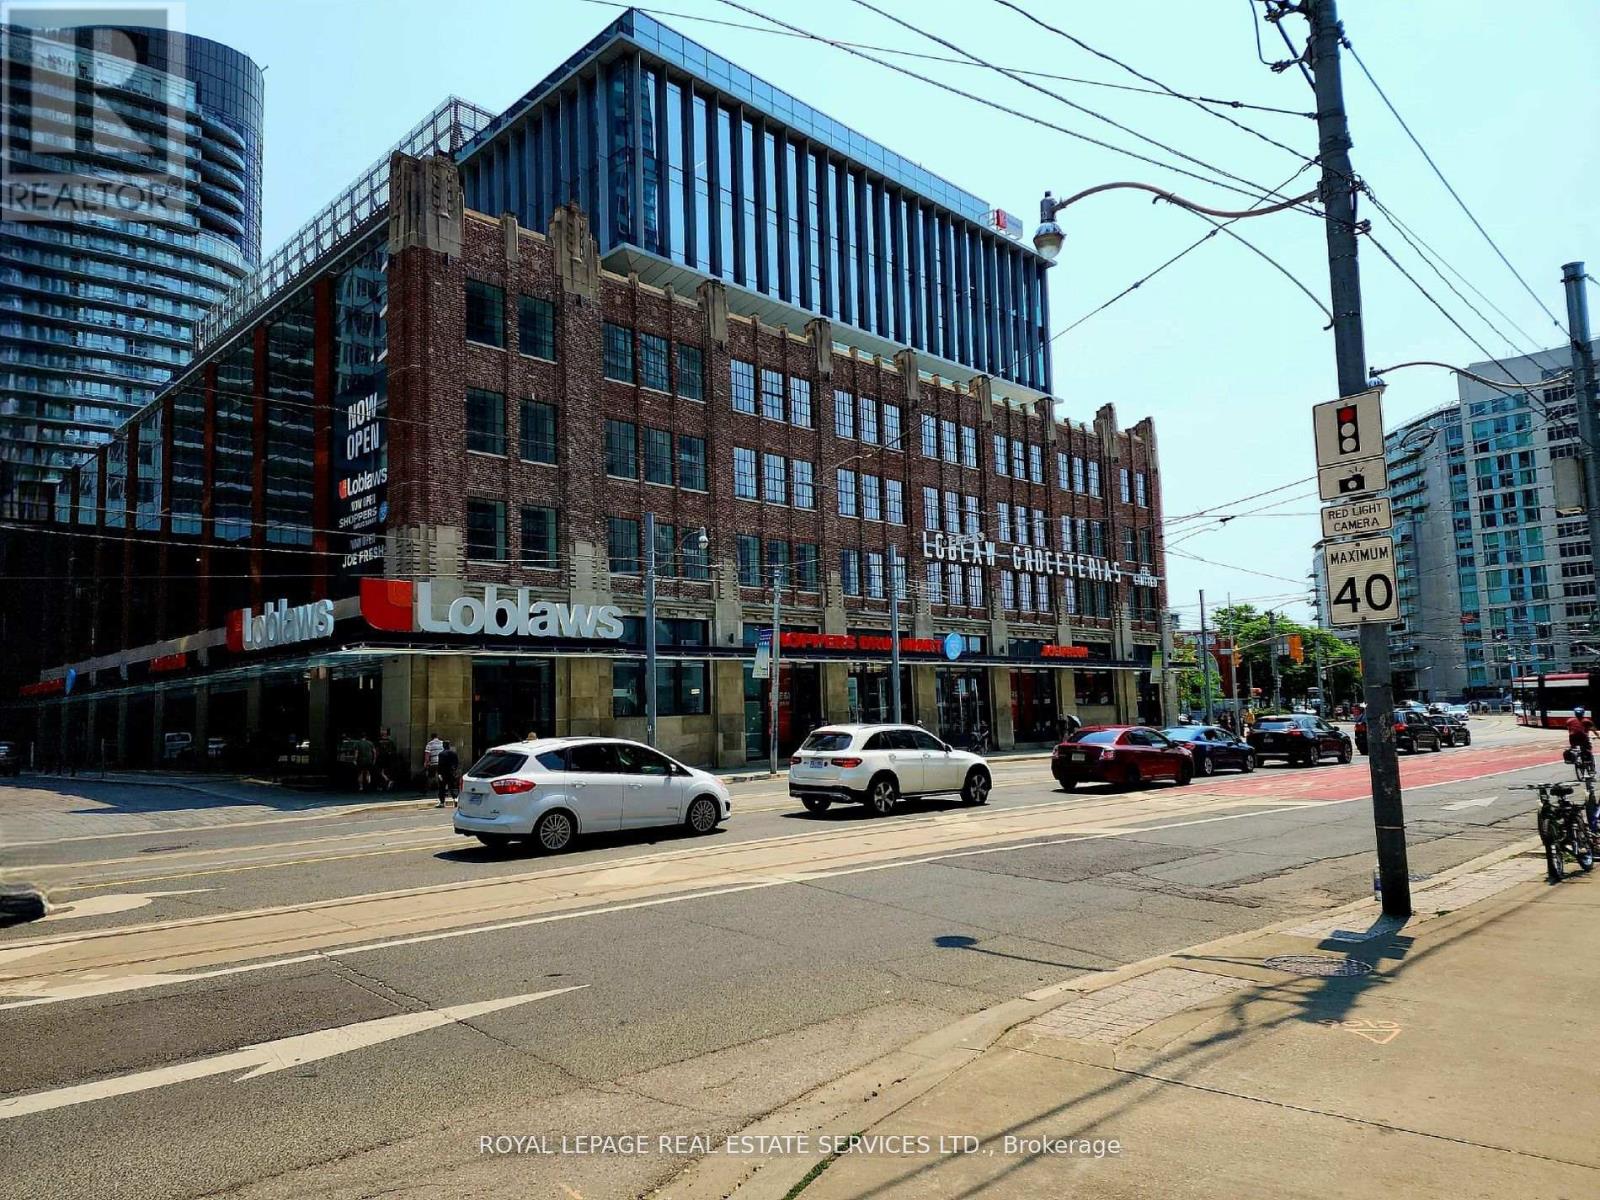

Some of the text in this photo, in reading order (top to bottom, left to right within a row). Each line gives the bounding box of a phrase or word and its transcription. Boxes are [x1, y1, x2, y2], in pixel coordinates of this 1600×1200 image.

[348, 392, 378, 431] NOW
[347, 422, 380, 460] OPEN
[347, 467, 388, 496] Loblaws
[338, 507, 378, 529] SHOPPERS
[1327, 503, 1383, 521] RED LIGHT
[1333, 517, 1380, 533] CAMERA
[342, 544, 385, 569] JOE FRESH
[1012, 545, 1122, 583] GROCETERIAS
[1330, 546, 1390, 566] MAXIMUM
[1332, 573, 1394, 613] 40
[242, 598, 335, 650] Loblaws
[417, 581, 625, 639] Loblaws
